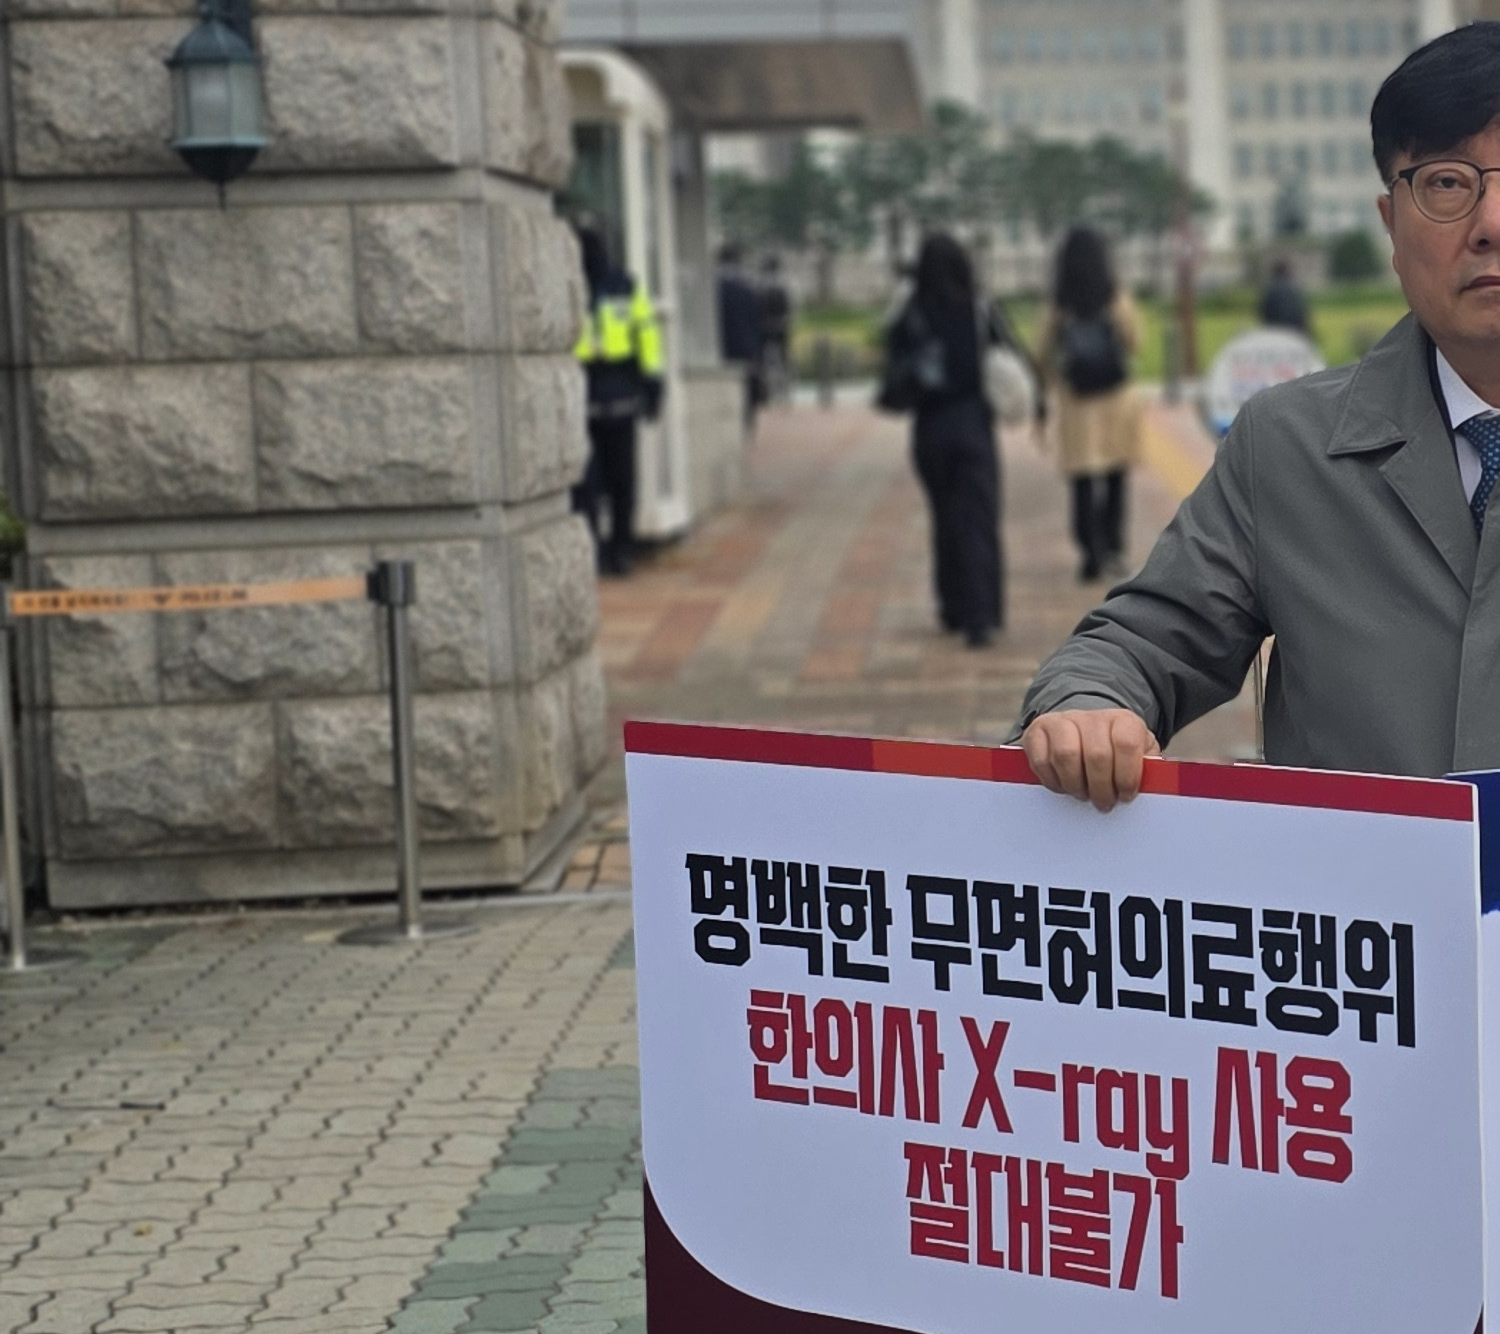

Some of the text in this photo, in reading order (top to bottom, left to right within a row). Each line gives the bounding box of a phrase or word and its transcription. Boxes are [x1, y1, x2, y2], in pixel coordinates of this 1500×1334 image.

[685, 853, 1415, 1048] 명백한 무면허의료행위
[747, 989, 1352, 1183] 한의사 X-ray 사용
[904, 1142, 1183, 1299] 절대불가
